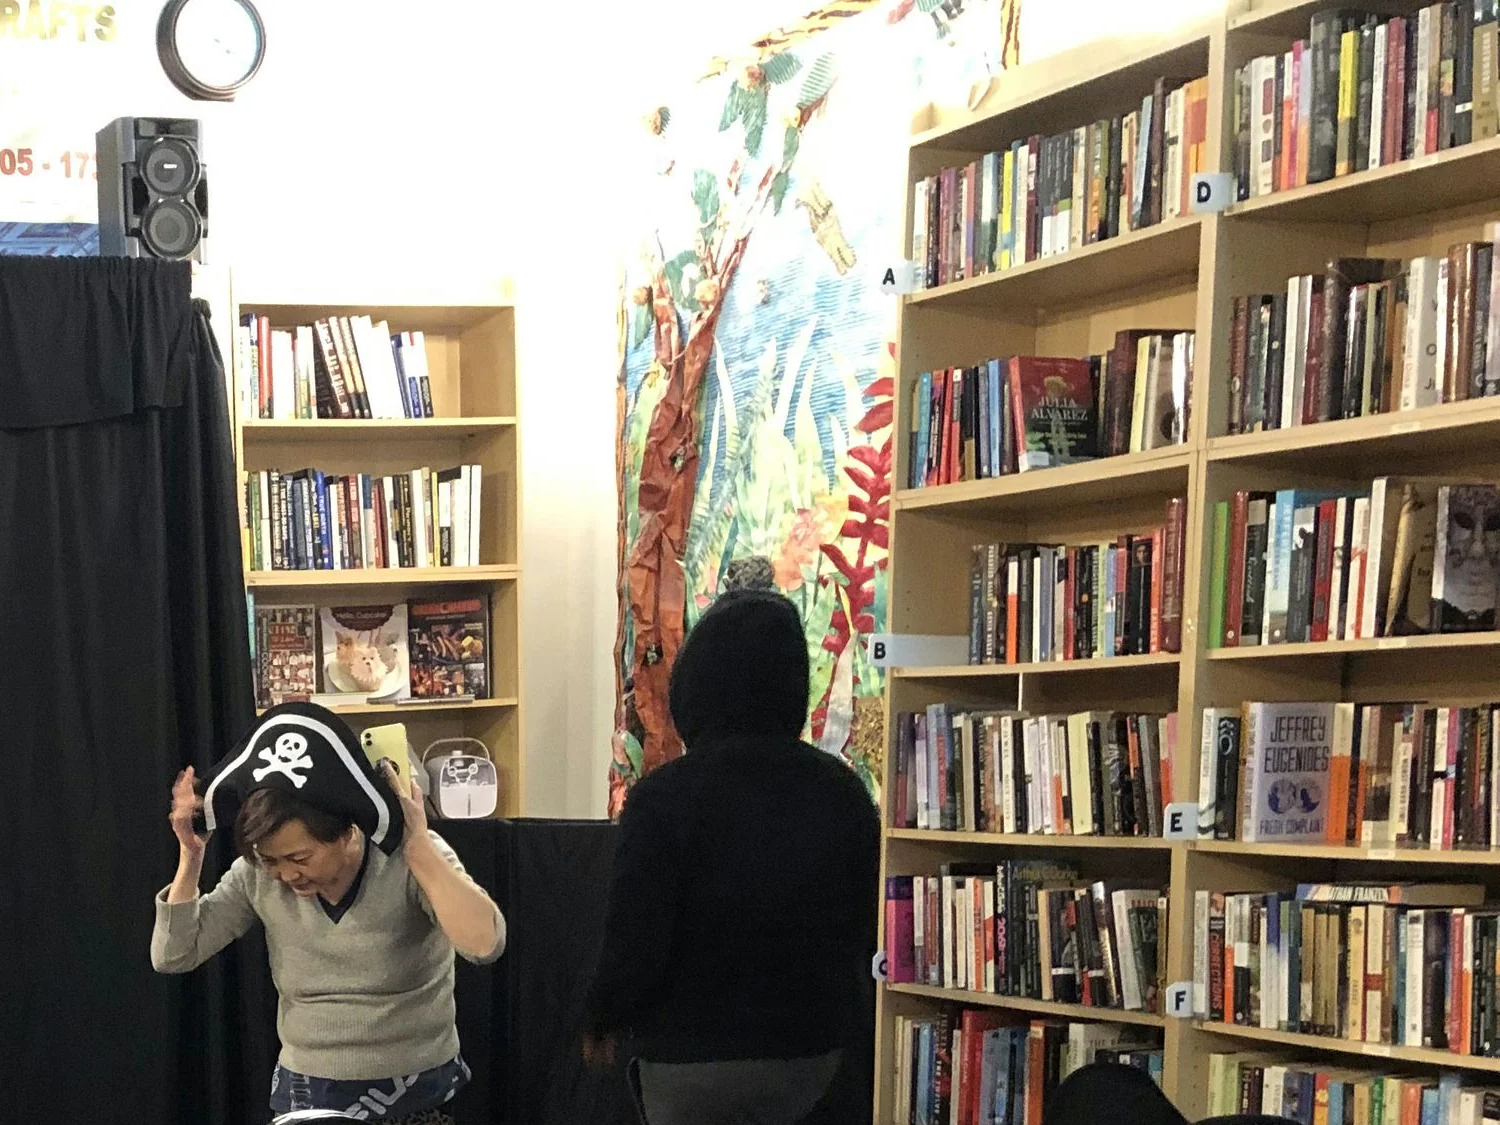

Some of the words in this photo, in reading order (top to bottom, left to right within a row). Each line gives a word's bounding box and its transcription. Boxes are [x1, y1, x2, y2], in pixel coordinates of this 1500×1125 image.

[1196, 182, 1213, 203] D
[882, 268, 897, 287] A
[1038, 396, 1078, 408] JULIA
[1031, 408, 1088, 420] ALVAREZ
[874, 641, 887, 660] B
[1270, 716, 1326, 742] JEFFREY
[1264, 746, 1330, 773] EUGENIDES
[1170, 812, 1184, 833] E
[1353, 886, 1388, 901] FRANZEN
[1210, 930, 1223, 1009] CORRECTIONS
[1174, 990, 1186, 1011] F
